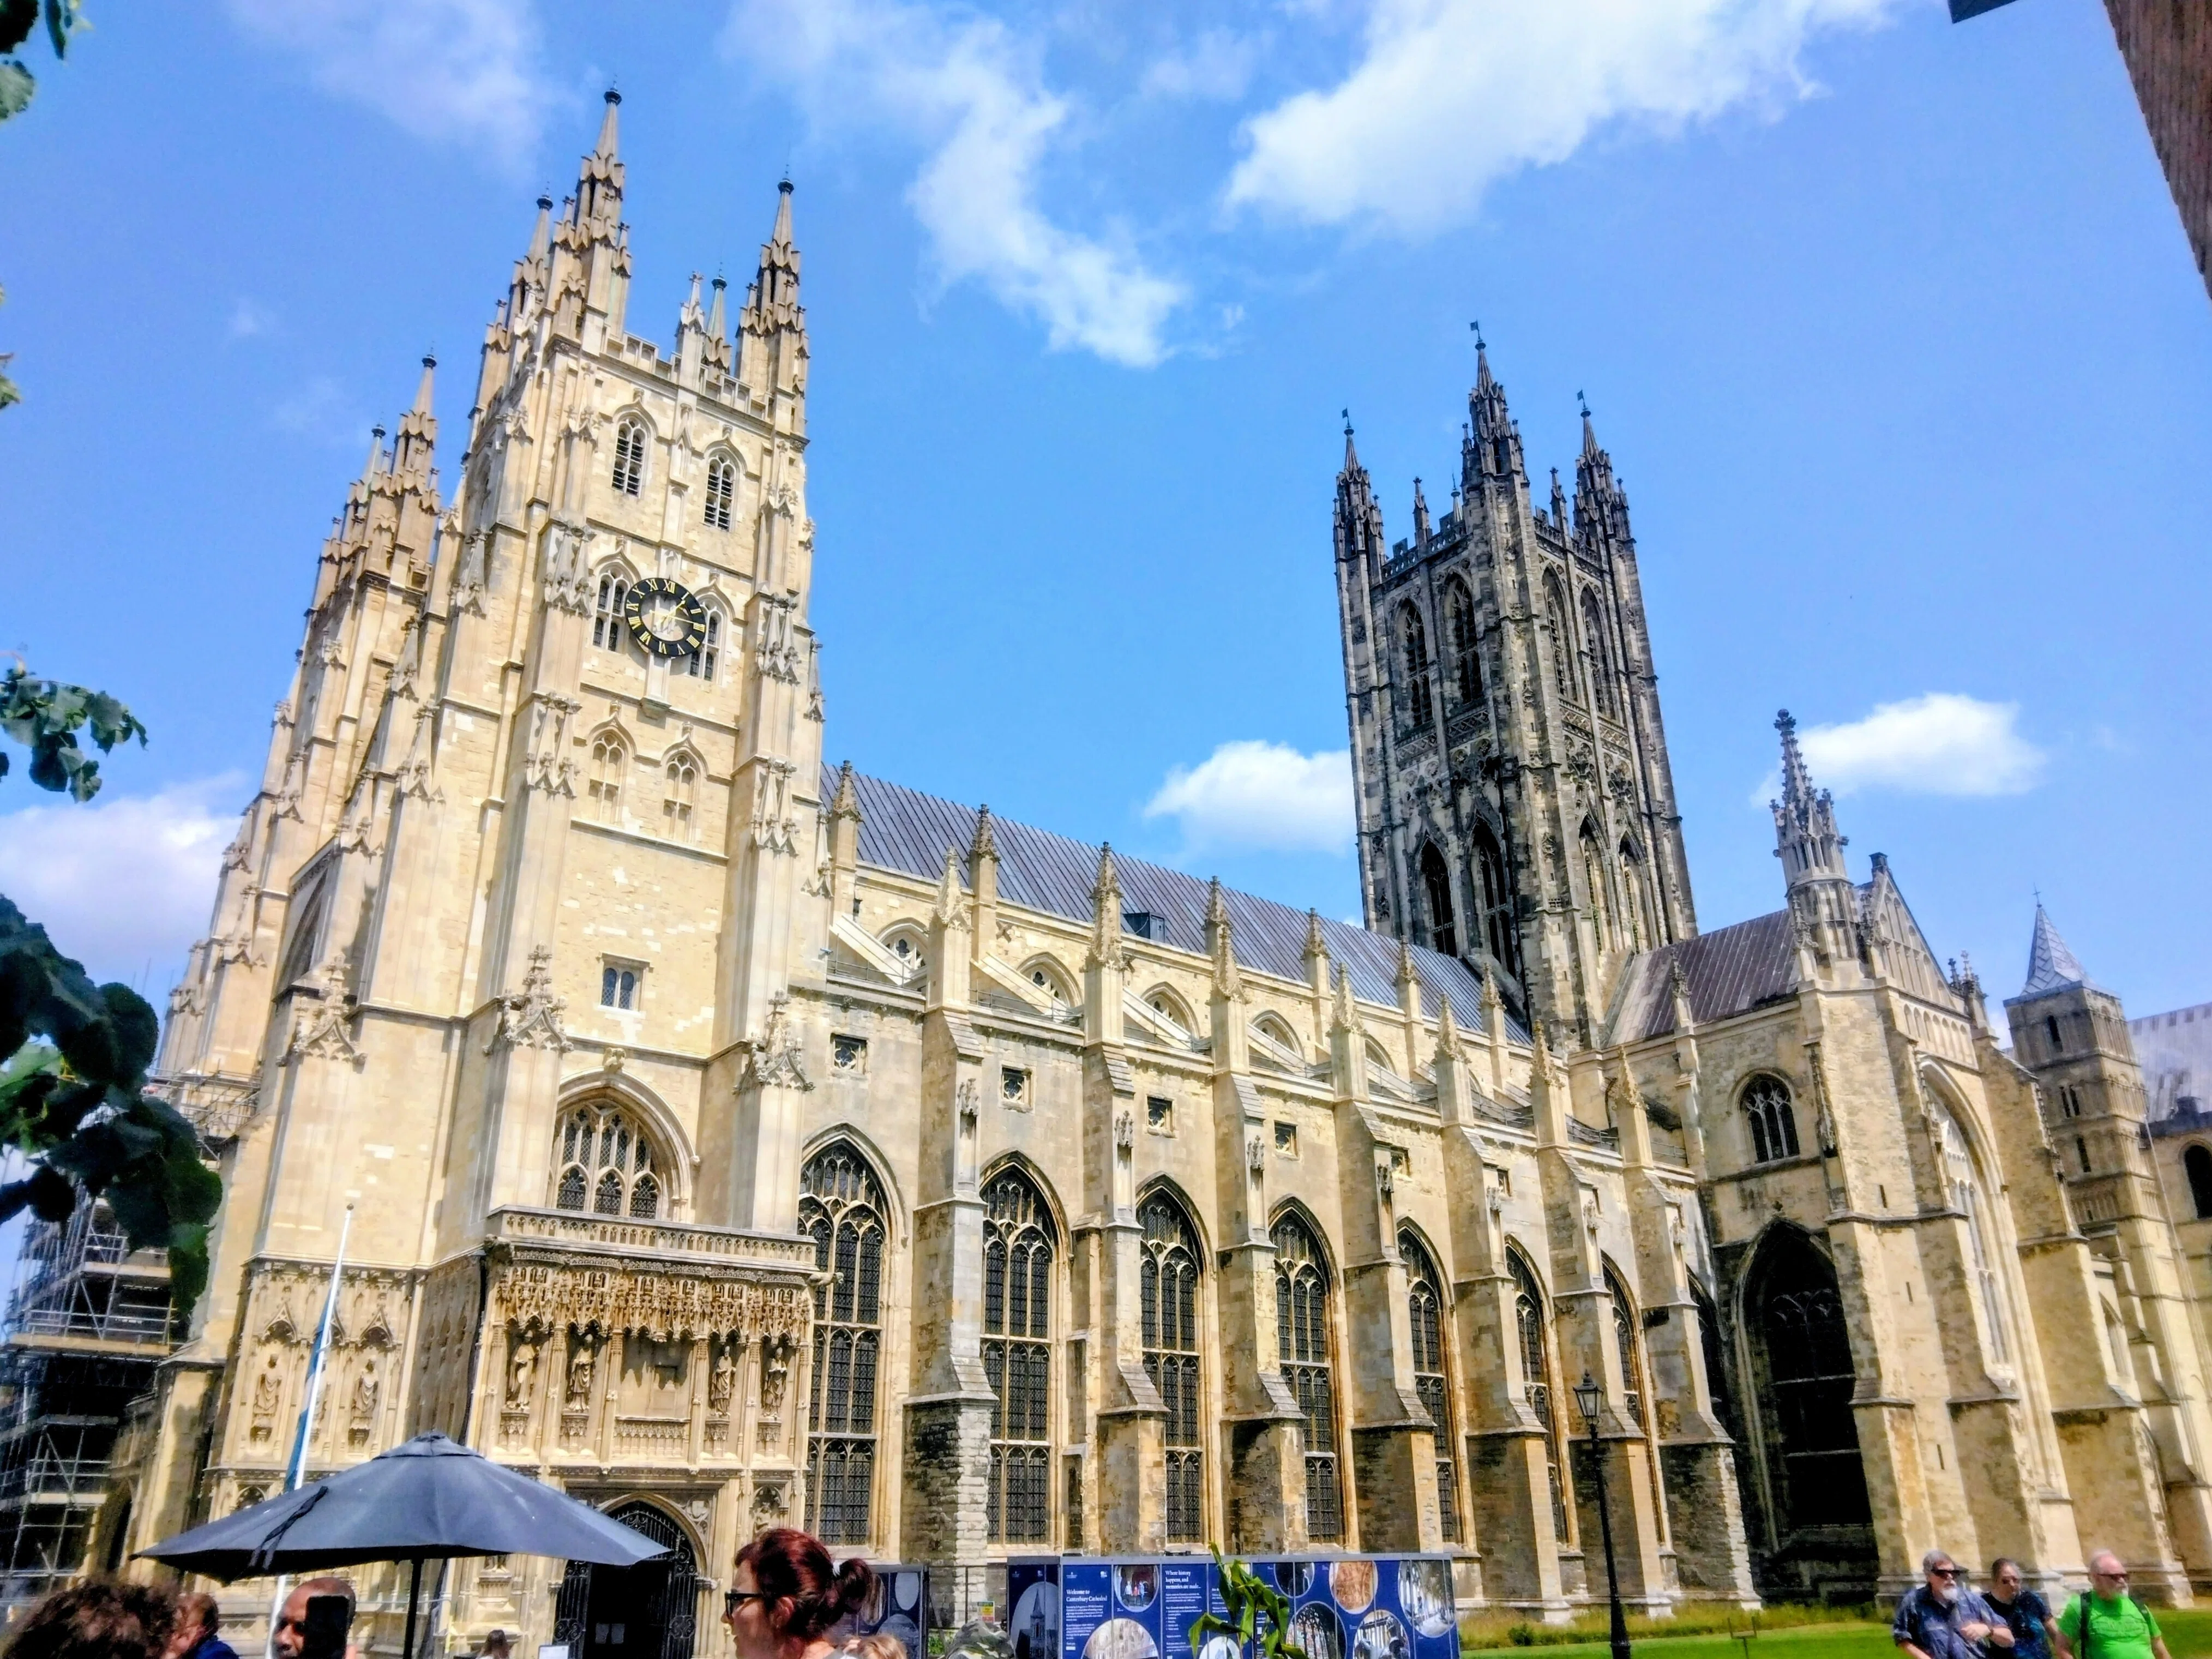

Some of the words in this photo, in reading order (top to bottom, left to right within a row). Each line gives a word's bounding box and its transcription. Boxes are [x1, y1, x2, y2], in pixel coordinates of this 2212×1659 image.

[632, 585, 645, 598] X
[646, 579, 659, 592] XI
[663, 579, 676, 594] XII
[639, 631, 652, 645] VII
[658, 641, 667, 654] VI
[677, 643, 686, 655] V
